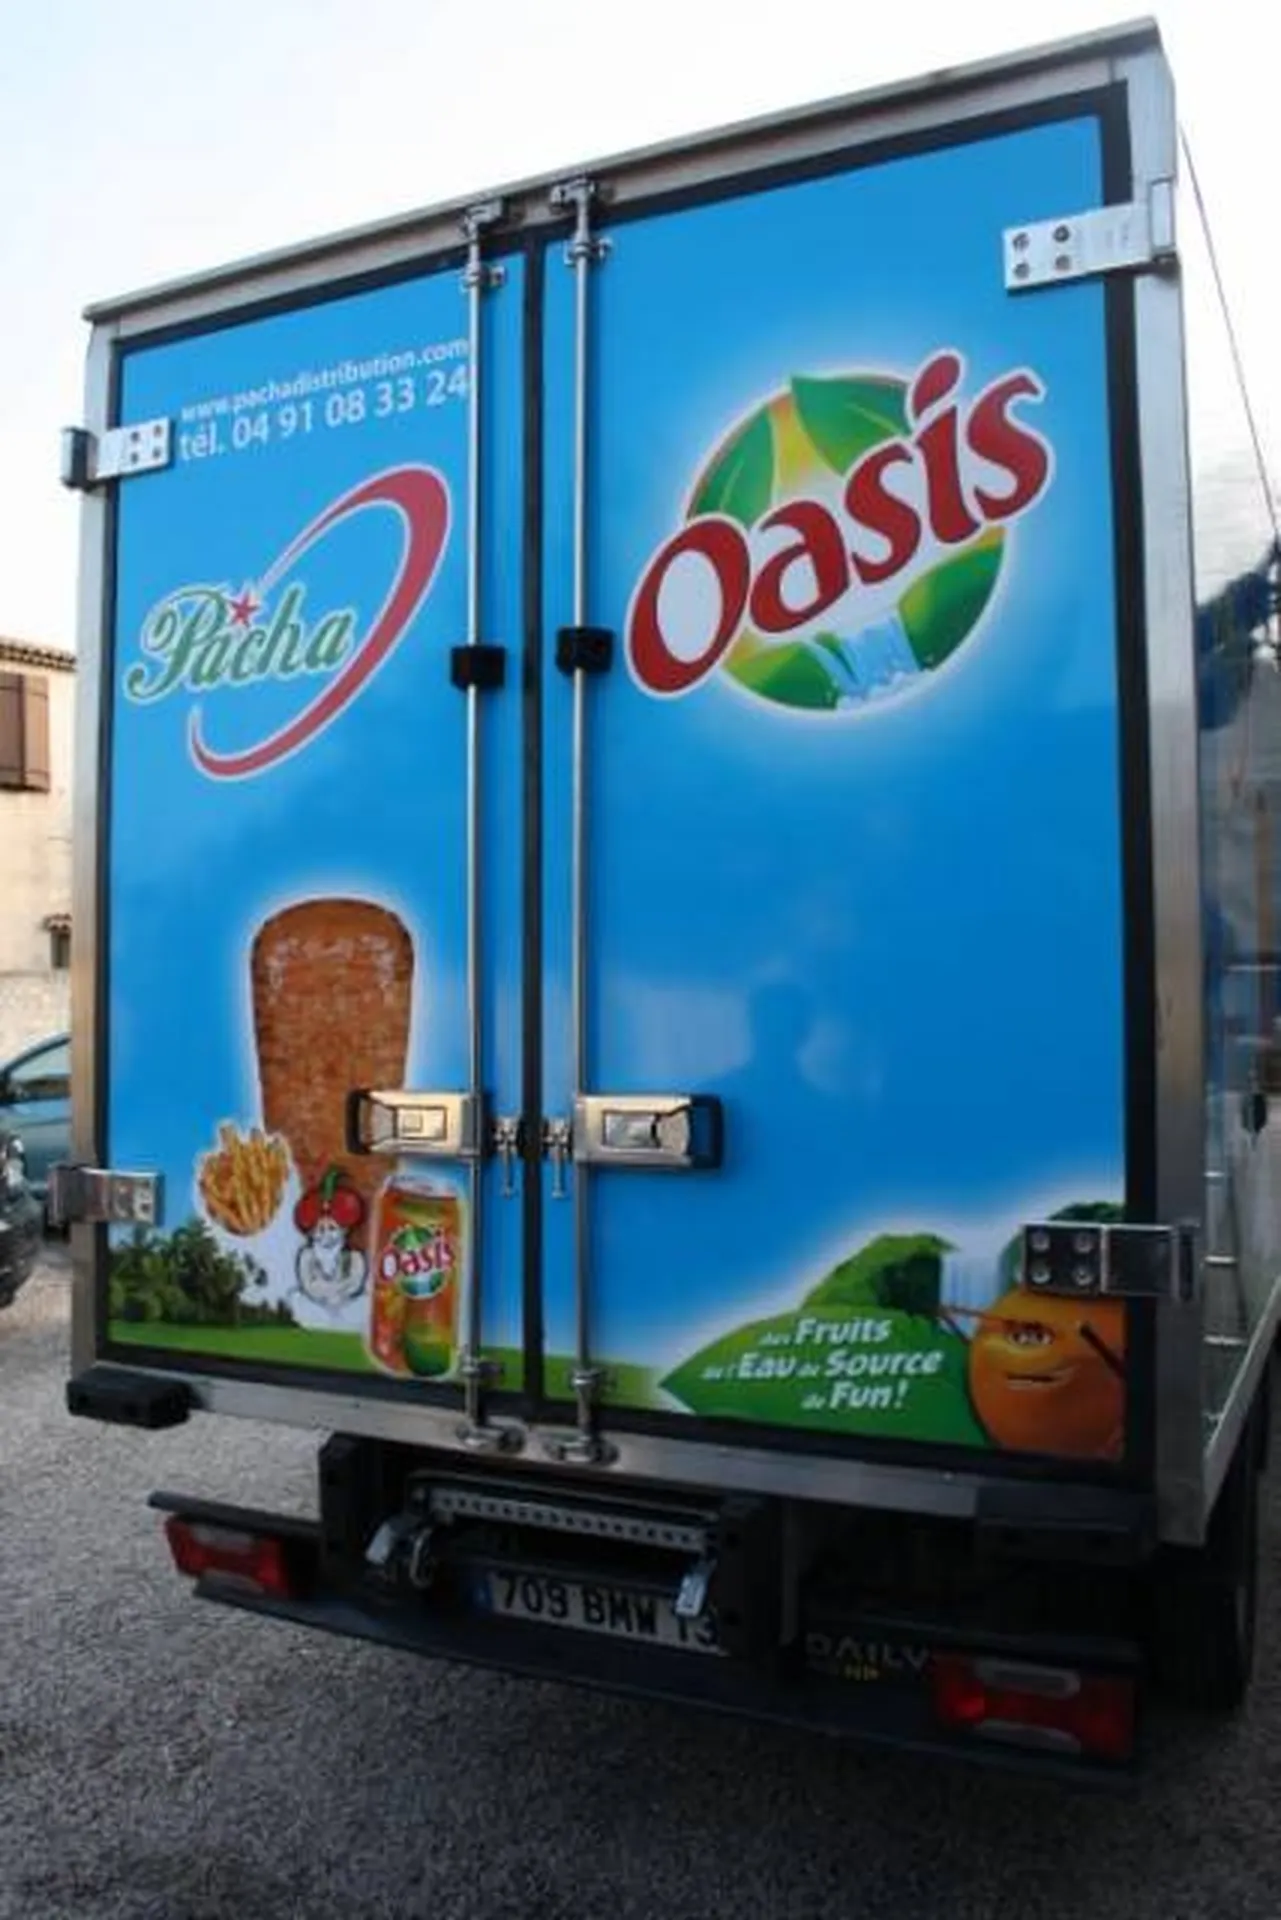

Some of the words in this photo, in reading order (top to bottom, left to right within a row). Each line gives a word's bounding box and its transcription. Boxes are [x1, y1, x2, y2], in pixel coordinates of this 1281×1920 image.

[233, 411, 271, 449] 04
[280, 402, 314, 440] 91
[325, 389, 366, 428] 08
[375, 377, 415, 418] 33
[426, 364, 468, 408] 24
[627, 351, 1051, 696] Oasis
[125, 583, 356, 702] Pacha
[380, 1228, 455, 1282] Oasis
[795, 1316, 893, 1345] Fruits
[824, 1349, 945, 1377] Source
